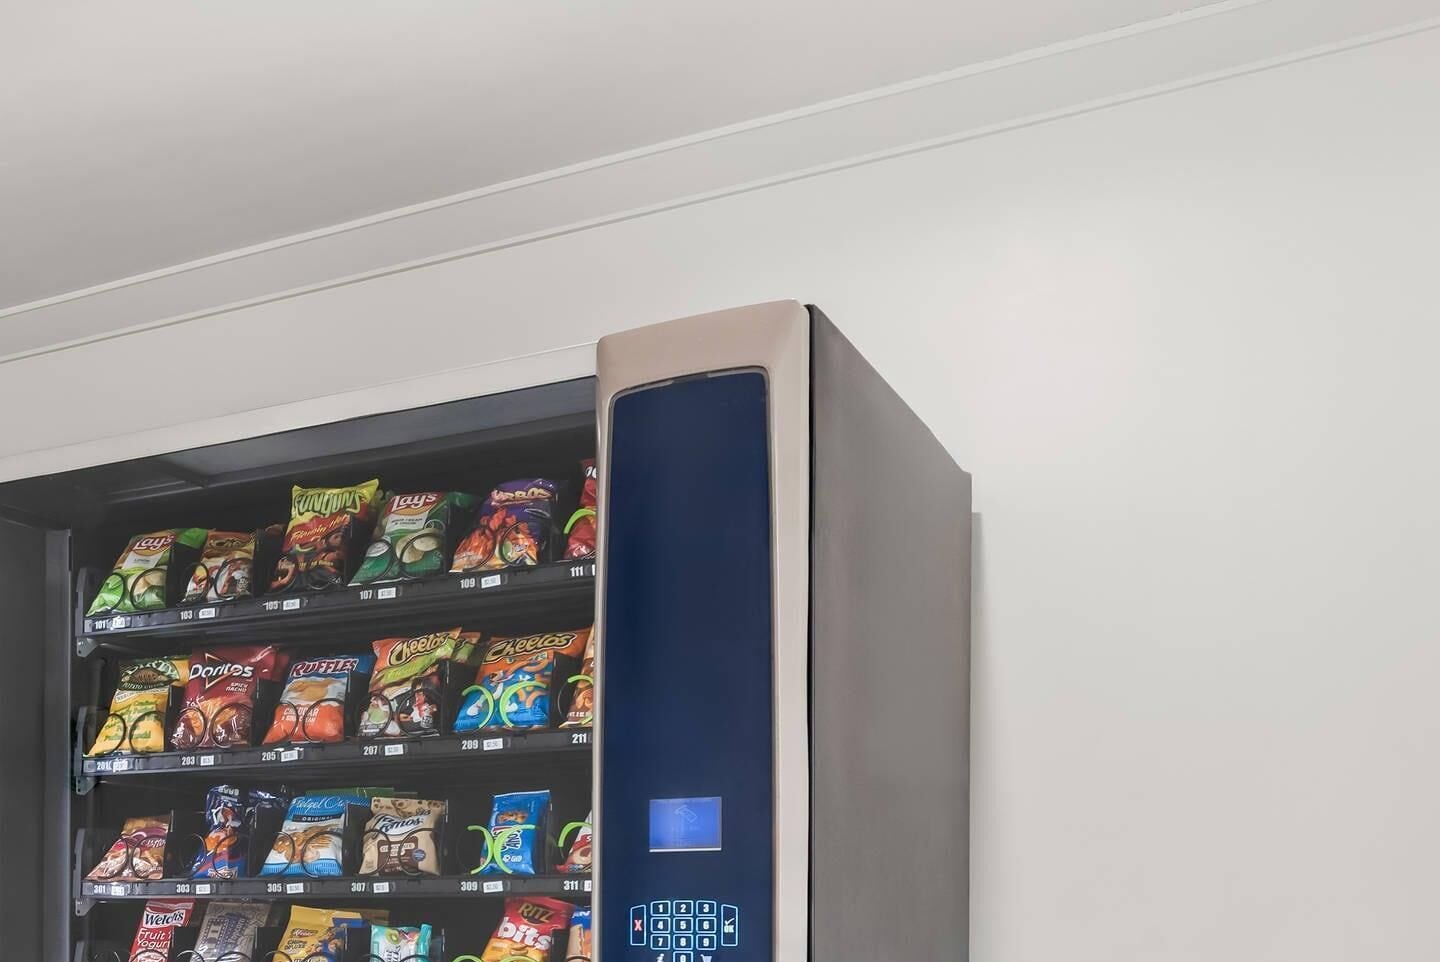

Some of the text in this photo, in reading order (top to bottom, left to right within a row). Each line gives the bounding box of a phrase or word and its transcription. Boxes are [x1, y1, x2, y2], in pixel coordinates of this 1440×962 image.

[295, 490, 361, 518] FUNYUNS
[391, 493, 438, 512] Lay's
[132, 534, 175, 551] Lay's
[570, 566, 583, 577] 111
[460, 578, 475, 589] 109
[359, 590, 372, 600] 107
[180, 610, 192, 620] 103
[484, 634, 574, 661] Cheetos
[189, 663, 254, 680] Doritos
[289, 658, 359, 678] RUFFLES
[571, 733, 587, 744] 211
[363, 745, 378, 755] 207
[181, 756, 195, 766] 203
[261, 751, 276, 761] 205
[93, 884, 106, 894] 301
[176, 884, 190, 893] 303
[267, 883, 282, 893] 305
[351, 882, 366, 892] 307
[460, 881, 478, 891] 309
[563, 880, 579, 890] 311
[519, 902, 555, 923] RITZ
[658, 904, 664, 913] 1
[680, 904, 686, 913] 2
[703, 904, 709, 913] 3
[657, 921, 664, 930] 4
[680, 921, 686, 930] 5
[703, 921, 709, 930] 6
[138, 928, 168, 941] Fruit
[497, 916, 552, 951] bits
[658, 938, 664, 947] 7
[680, 938, 686, 947] 8
[703, 938, 709, 947] 9
